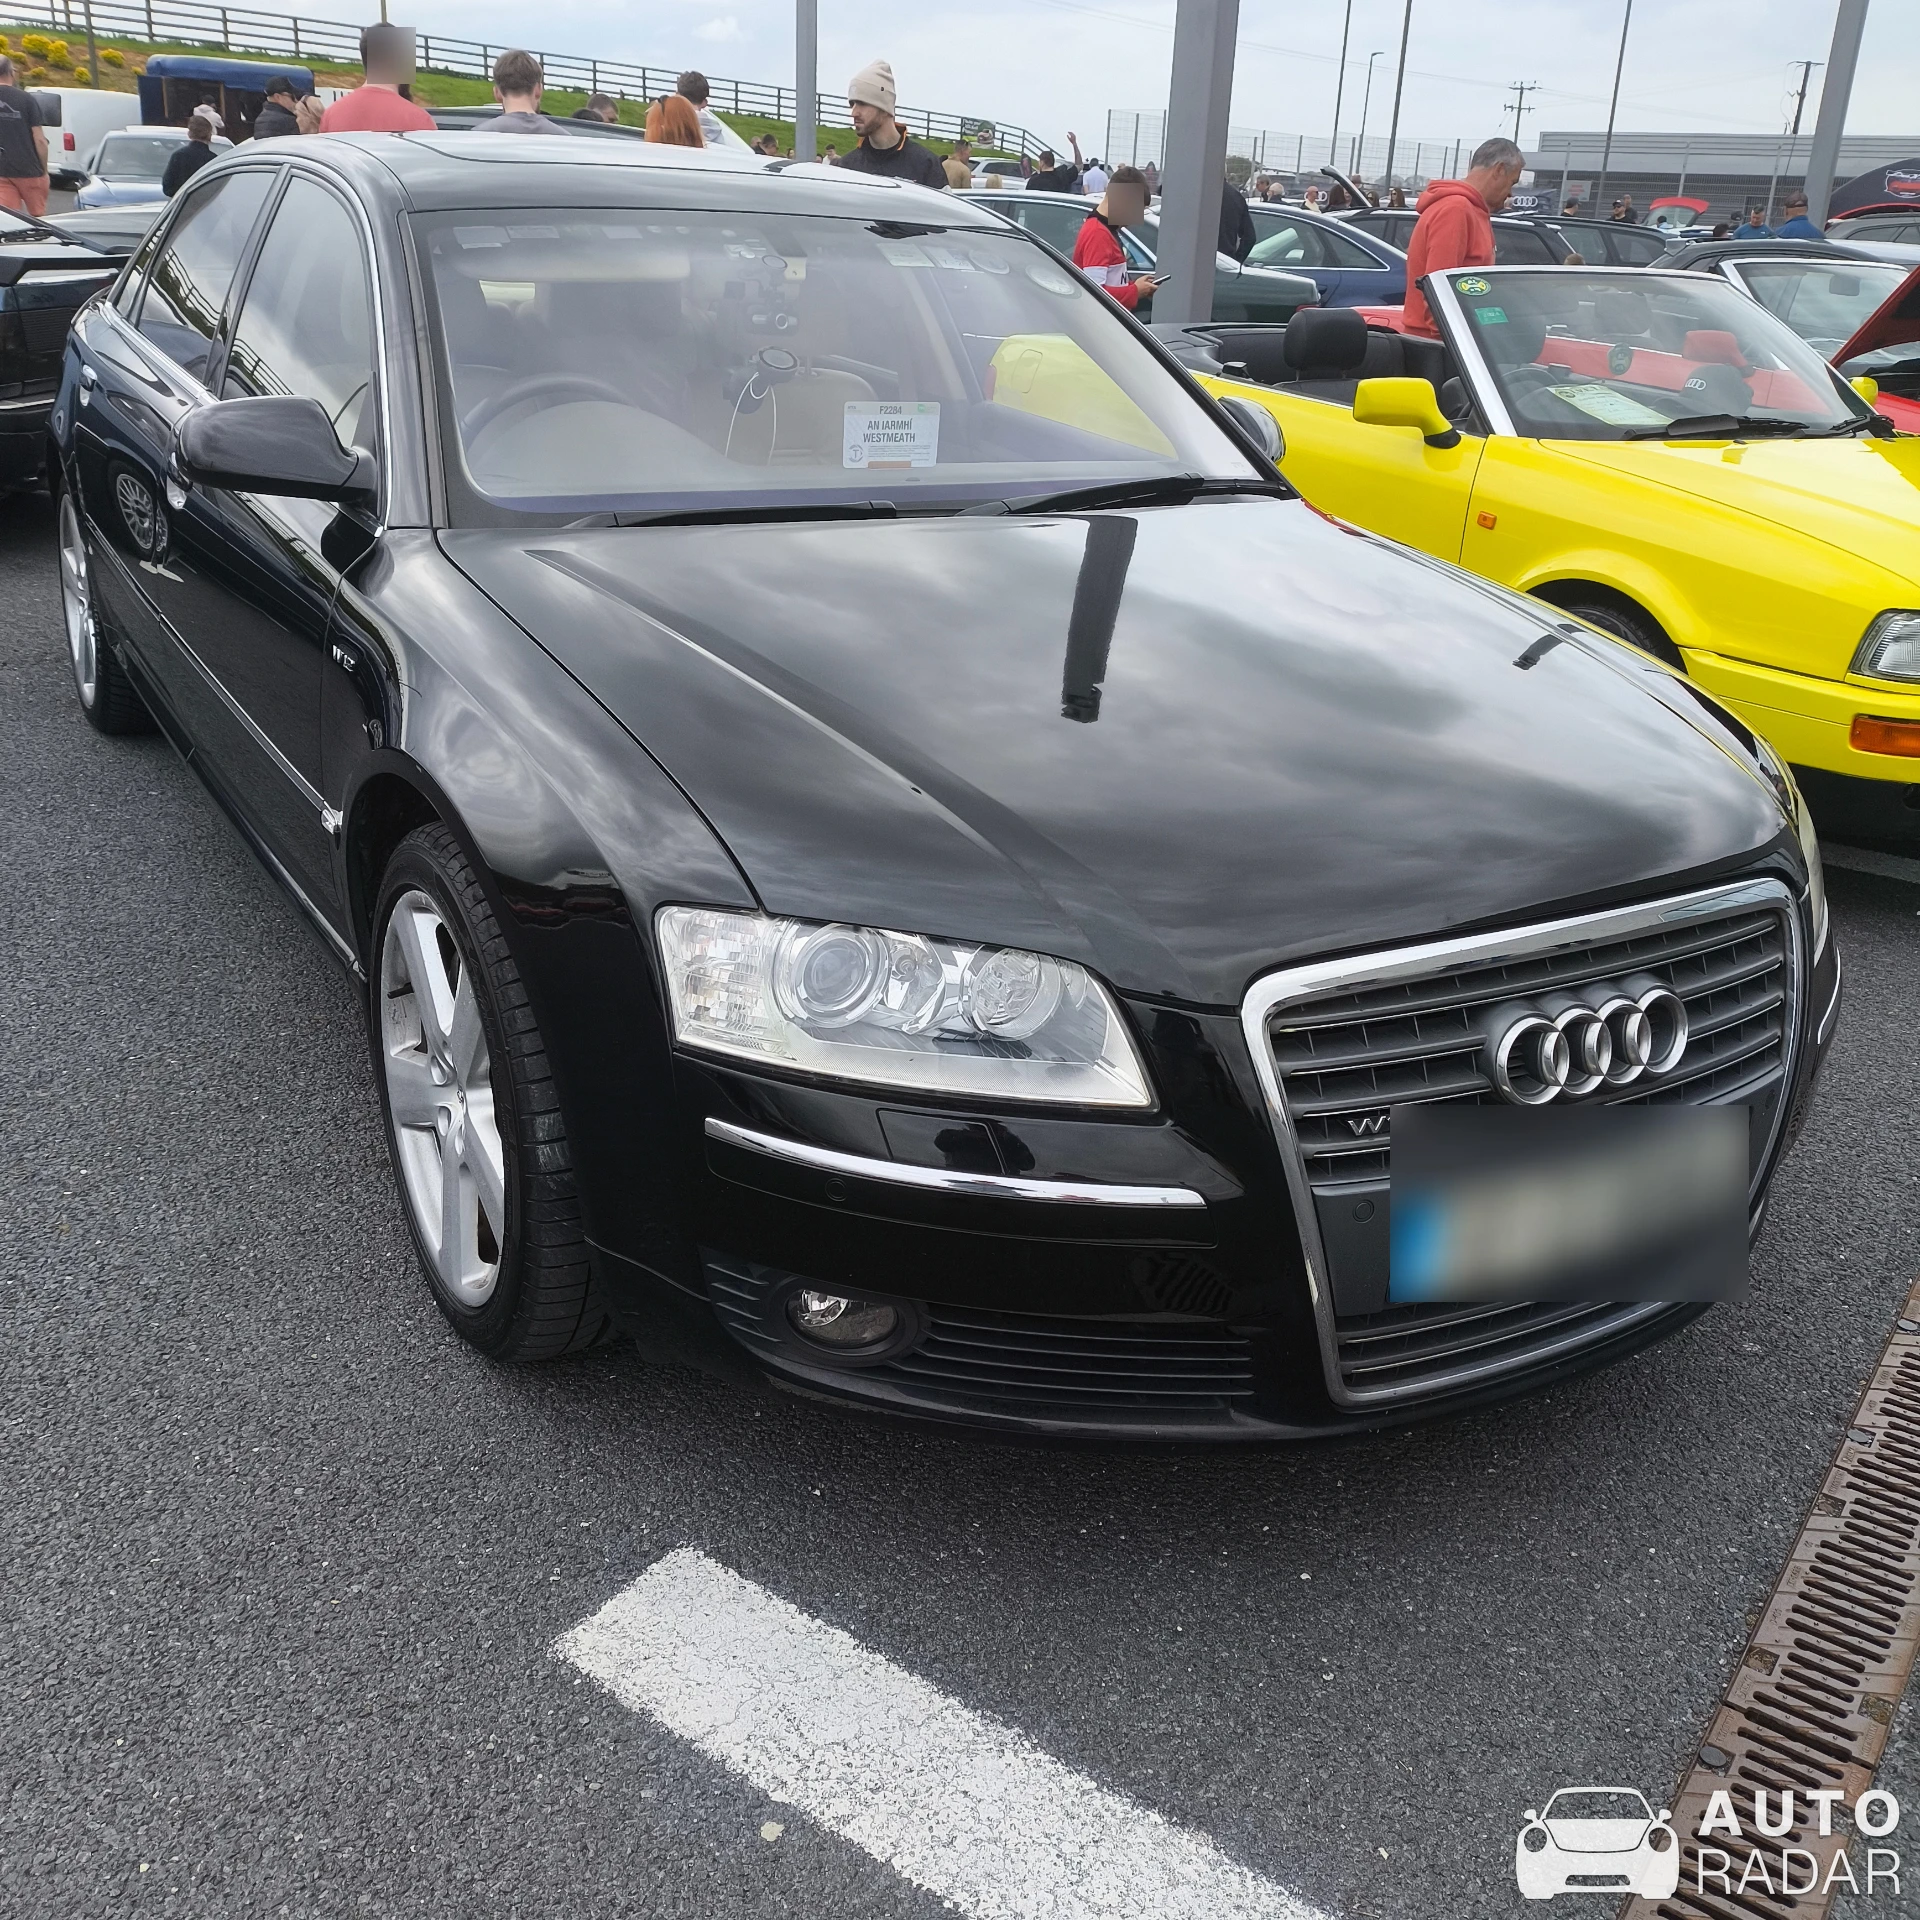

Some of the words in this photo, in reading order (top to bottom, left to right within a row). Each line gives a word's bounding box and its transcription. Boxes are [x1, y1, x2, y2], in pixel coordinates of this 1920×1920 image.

[879, 405, 902, 414] F2284
[867, 420, 880, 431] AN
[881, 417, 913, 431] IARMHÍ
[863, 433, 916, 443] WESTMEATH
[1347, 1115, 1390, 1136] W
